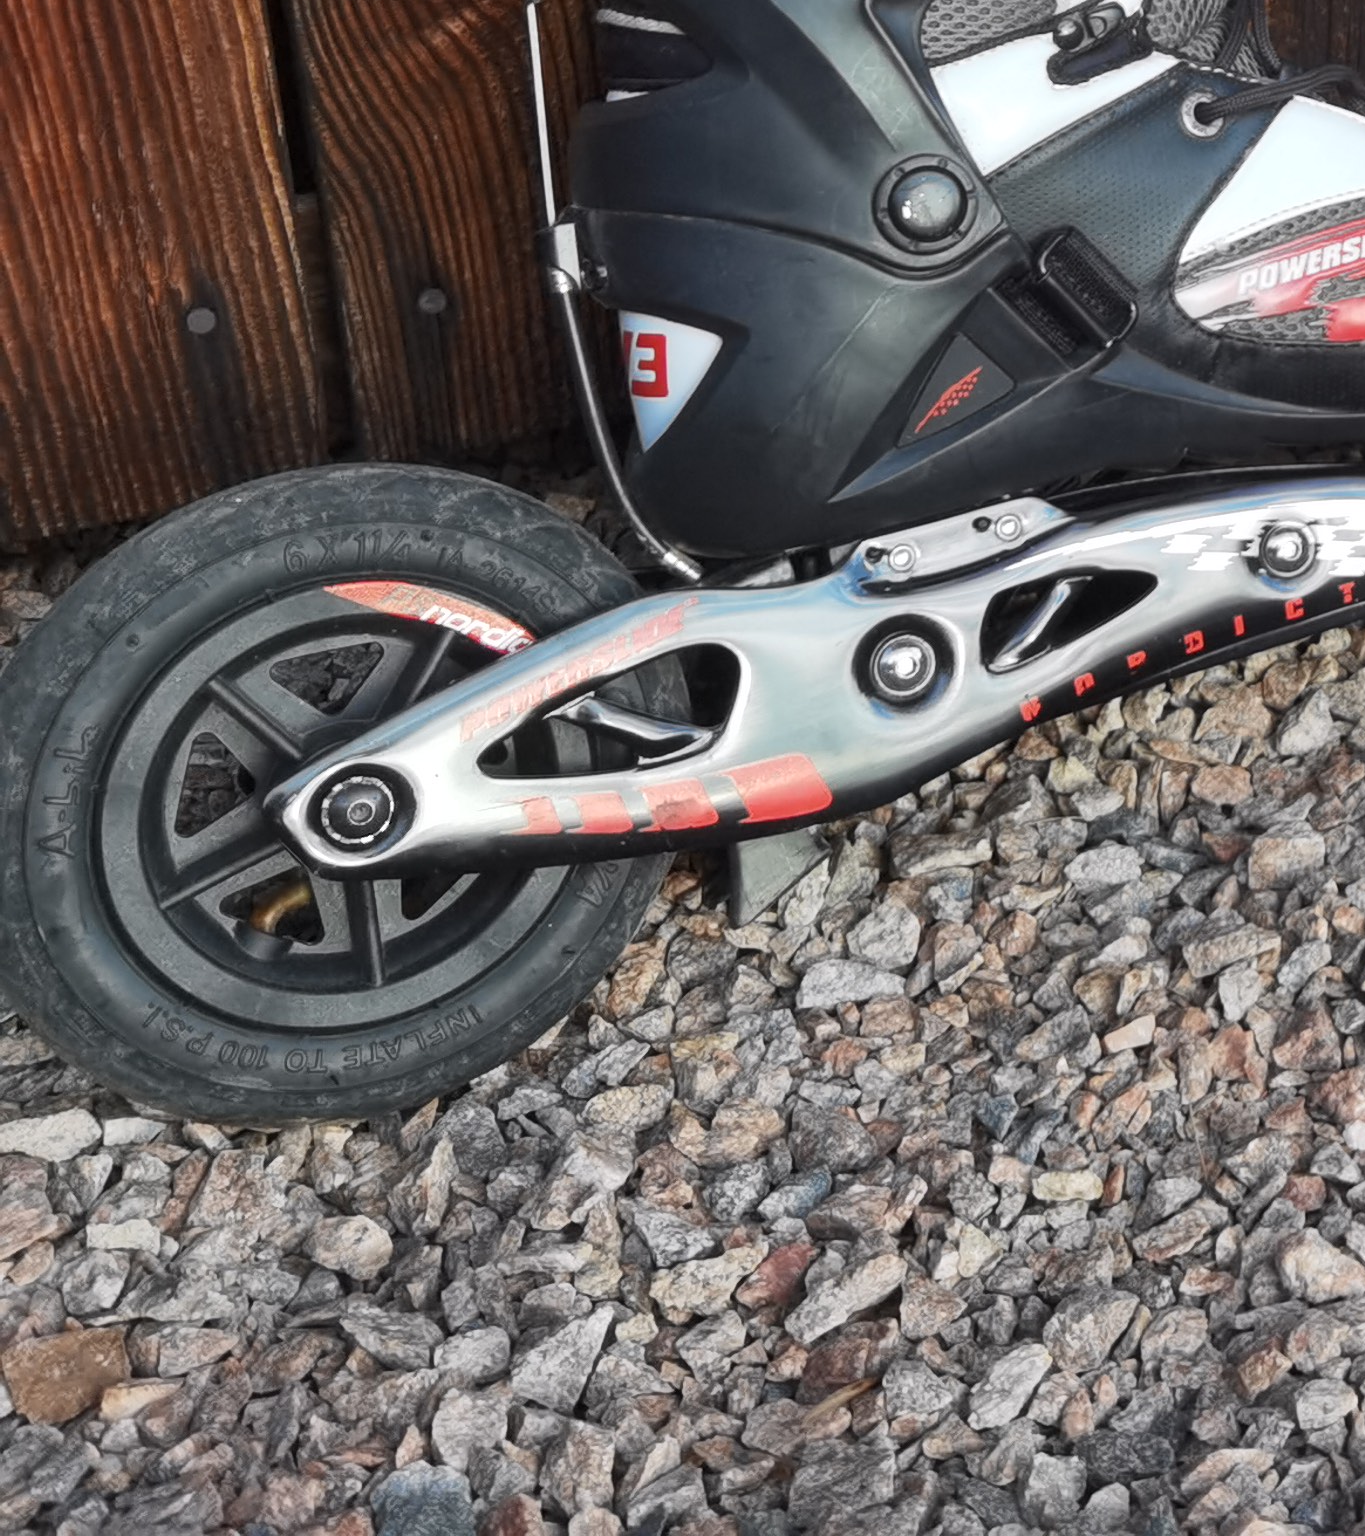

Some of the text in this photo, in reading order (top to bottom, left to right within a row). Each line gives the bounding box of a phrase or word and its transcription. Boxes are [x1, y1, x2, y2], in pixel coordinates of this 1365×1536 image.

[419, 603, 534, 655] nordic
[218, 1039, 270, 1071] 100
[341, 1003, 483, 1071] INFLATE
[283, 1048, 328, 1074] TO
